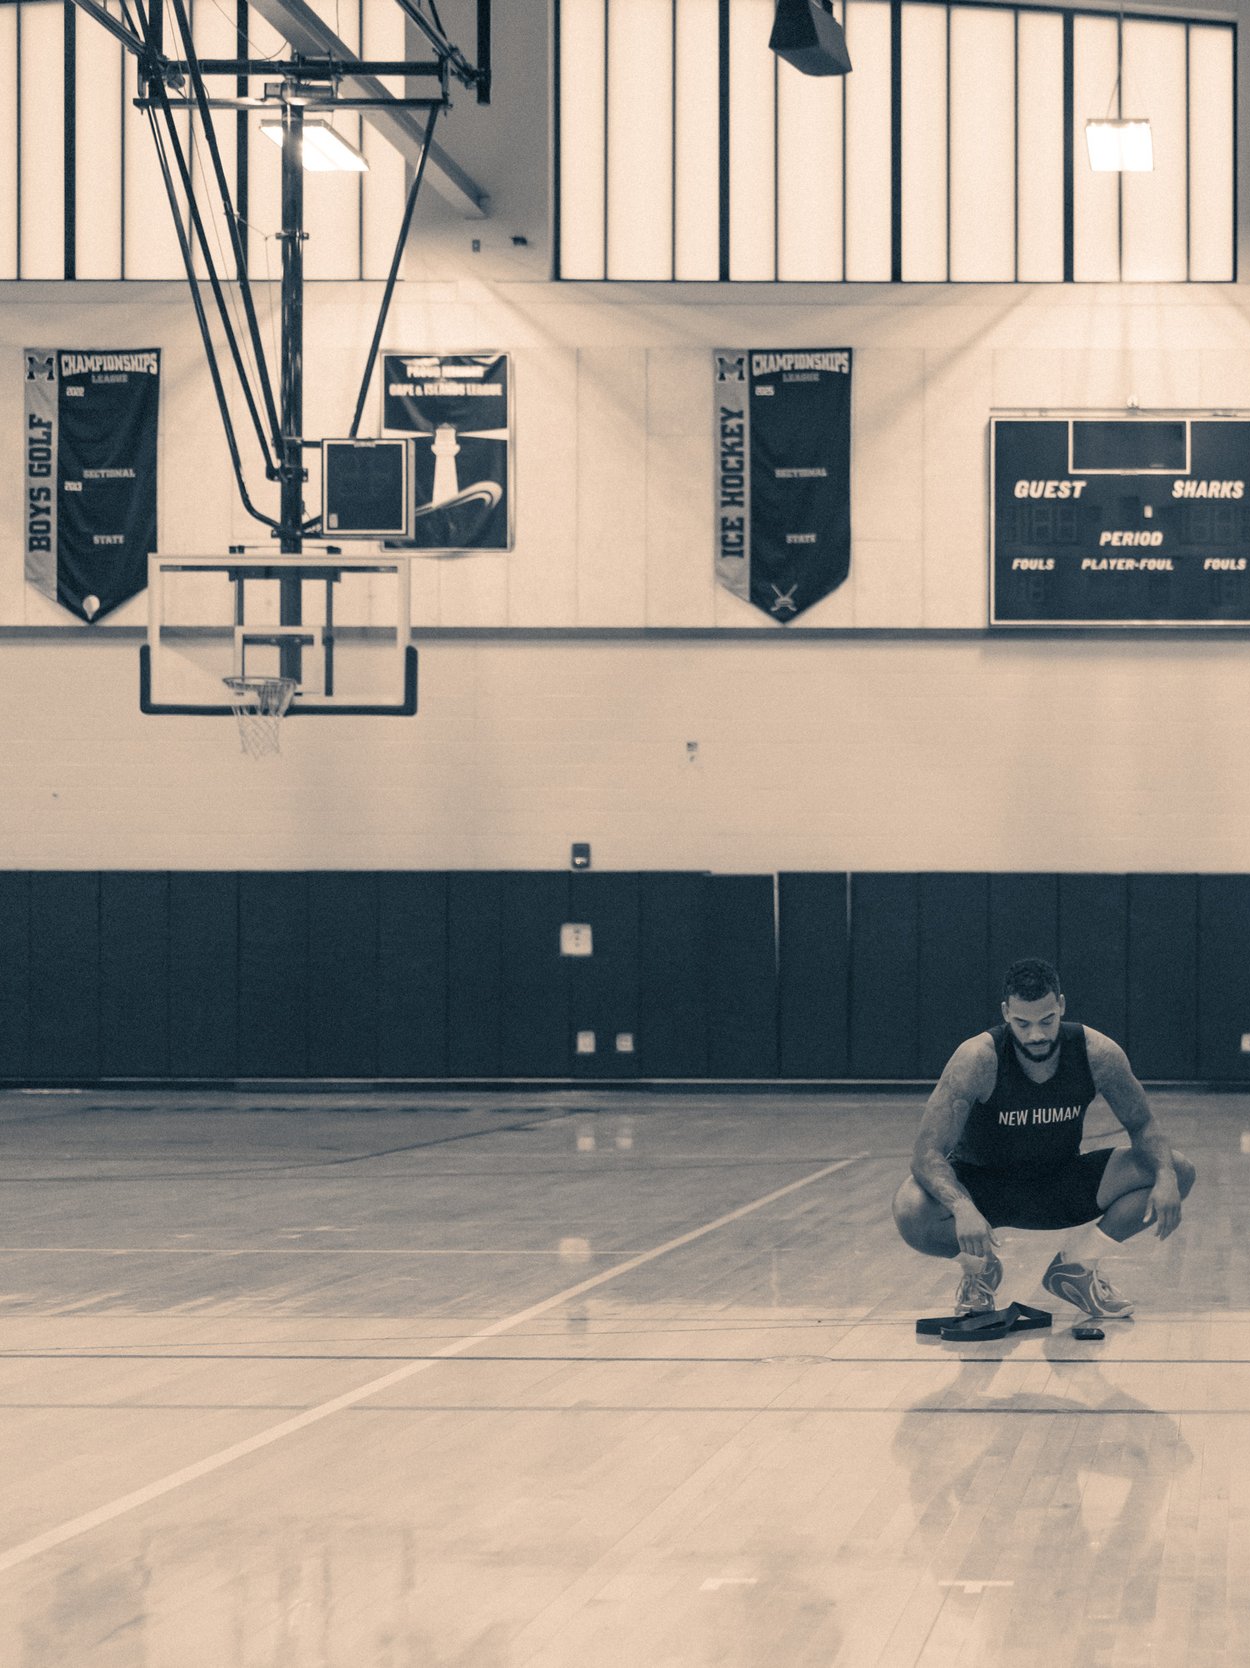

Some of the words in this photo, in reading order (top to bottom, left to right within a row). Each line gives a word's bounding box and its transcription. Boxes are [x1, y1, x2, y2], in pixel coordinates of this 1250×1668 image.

[61, 352, 158, 377] CHAMPIONSHIPS
[751, 351, 849, 377] CHAMPIONSHIPS
[28, 413, 52, 478] GOLF
[720, 406, 745, 508] HOCKEY
[83, 468, 136, 479] SECTIONAL
[1014, 480, 1087, 499] GUEST
[1171, 480, 1245, 499] SHARKS
[28, 486, 52, 553] BOYS
[93, 534, 124, 544] STATE
[720, 516, 745, 559] ICE
[1099, 531, 1163, 546] PERIOD
[1012, 558, 1055, 570] FOULS
[1081, 558, 1175, 570] PLAYER-FOUL
[1203, 558, 1247, 570] FOULS
[998, 1109, 1029, 1126] NEW
[1032, 1105, 1081, 1125] HUMAN
